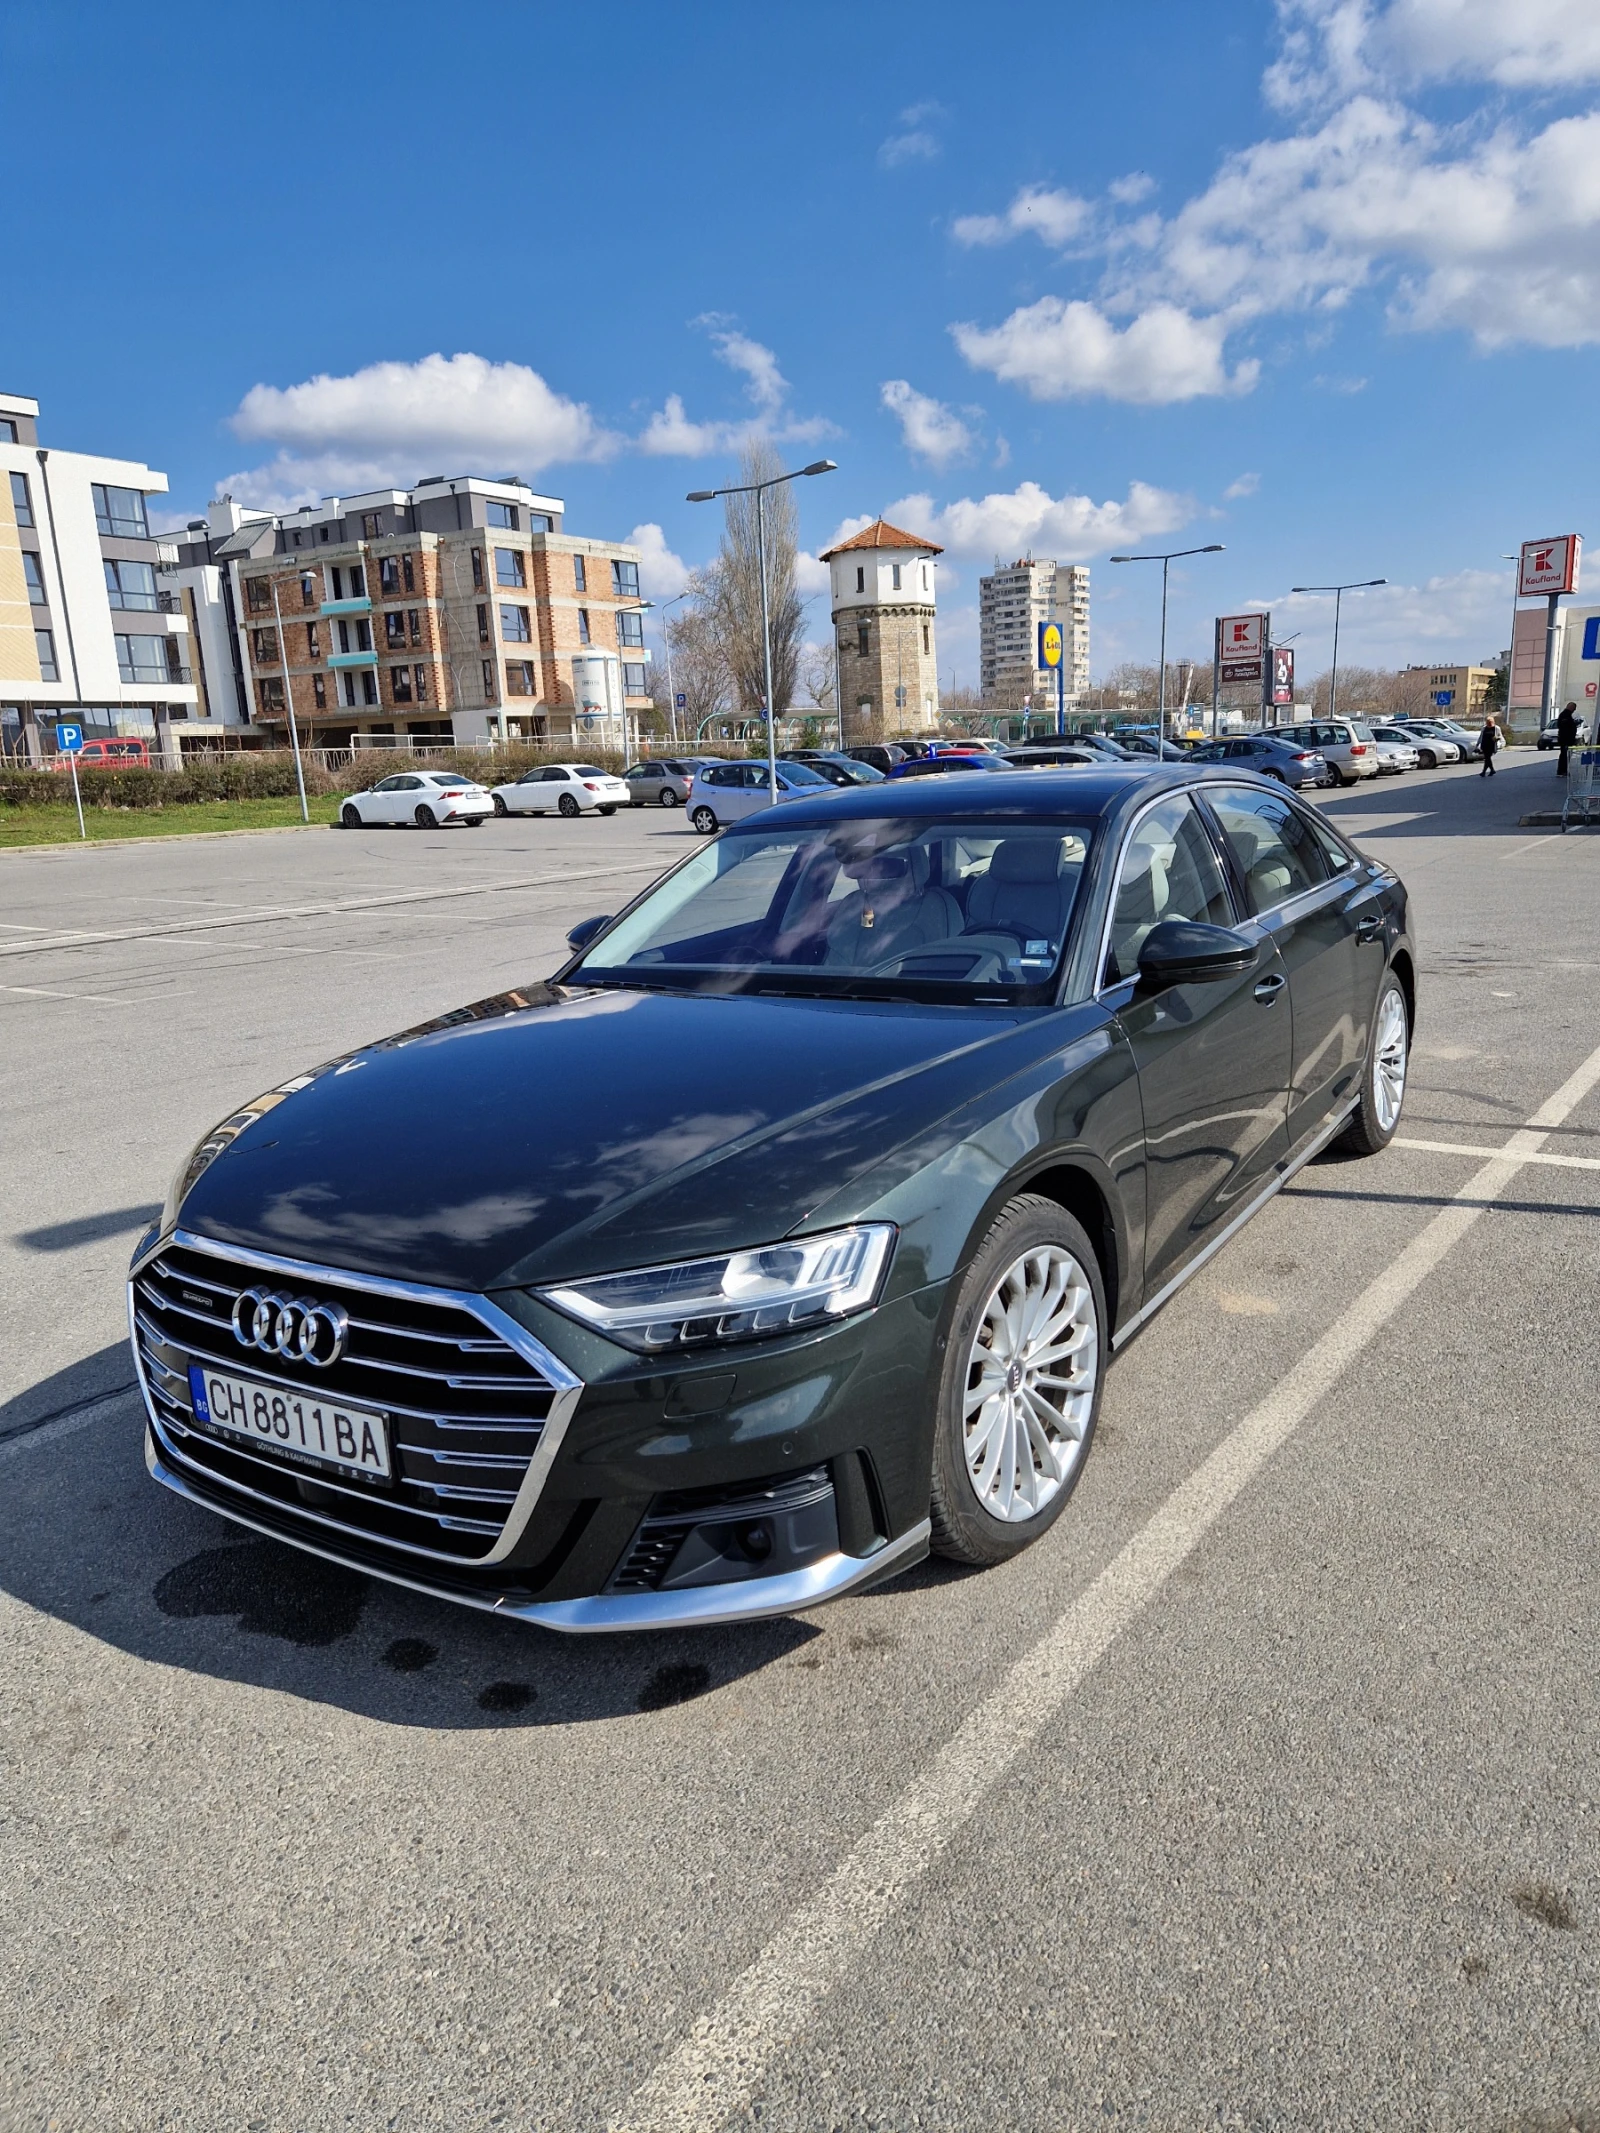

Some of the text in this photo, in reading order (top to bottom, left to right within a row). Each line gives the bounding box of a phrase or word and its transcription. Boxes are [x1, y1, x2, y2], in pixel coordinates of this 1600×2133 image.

[1526, 573, 1561, 585] Kaufland
[1226, 644, 1257, 652] Kaufland
[63, 727, 77, 747] P
[196, 1400, 209, 1413] BG
